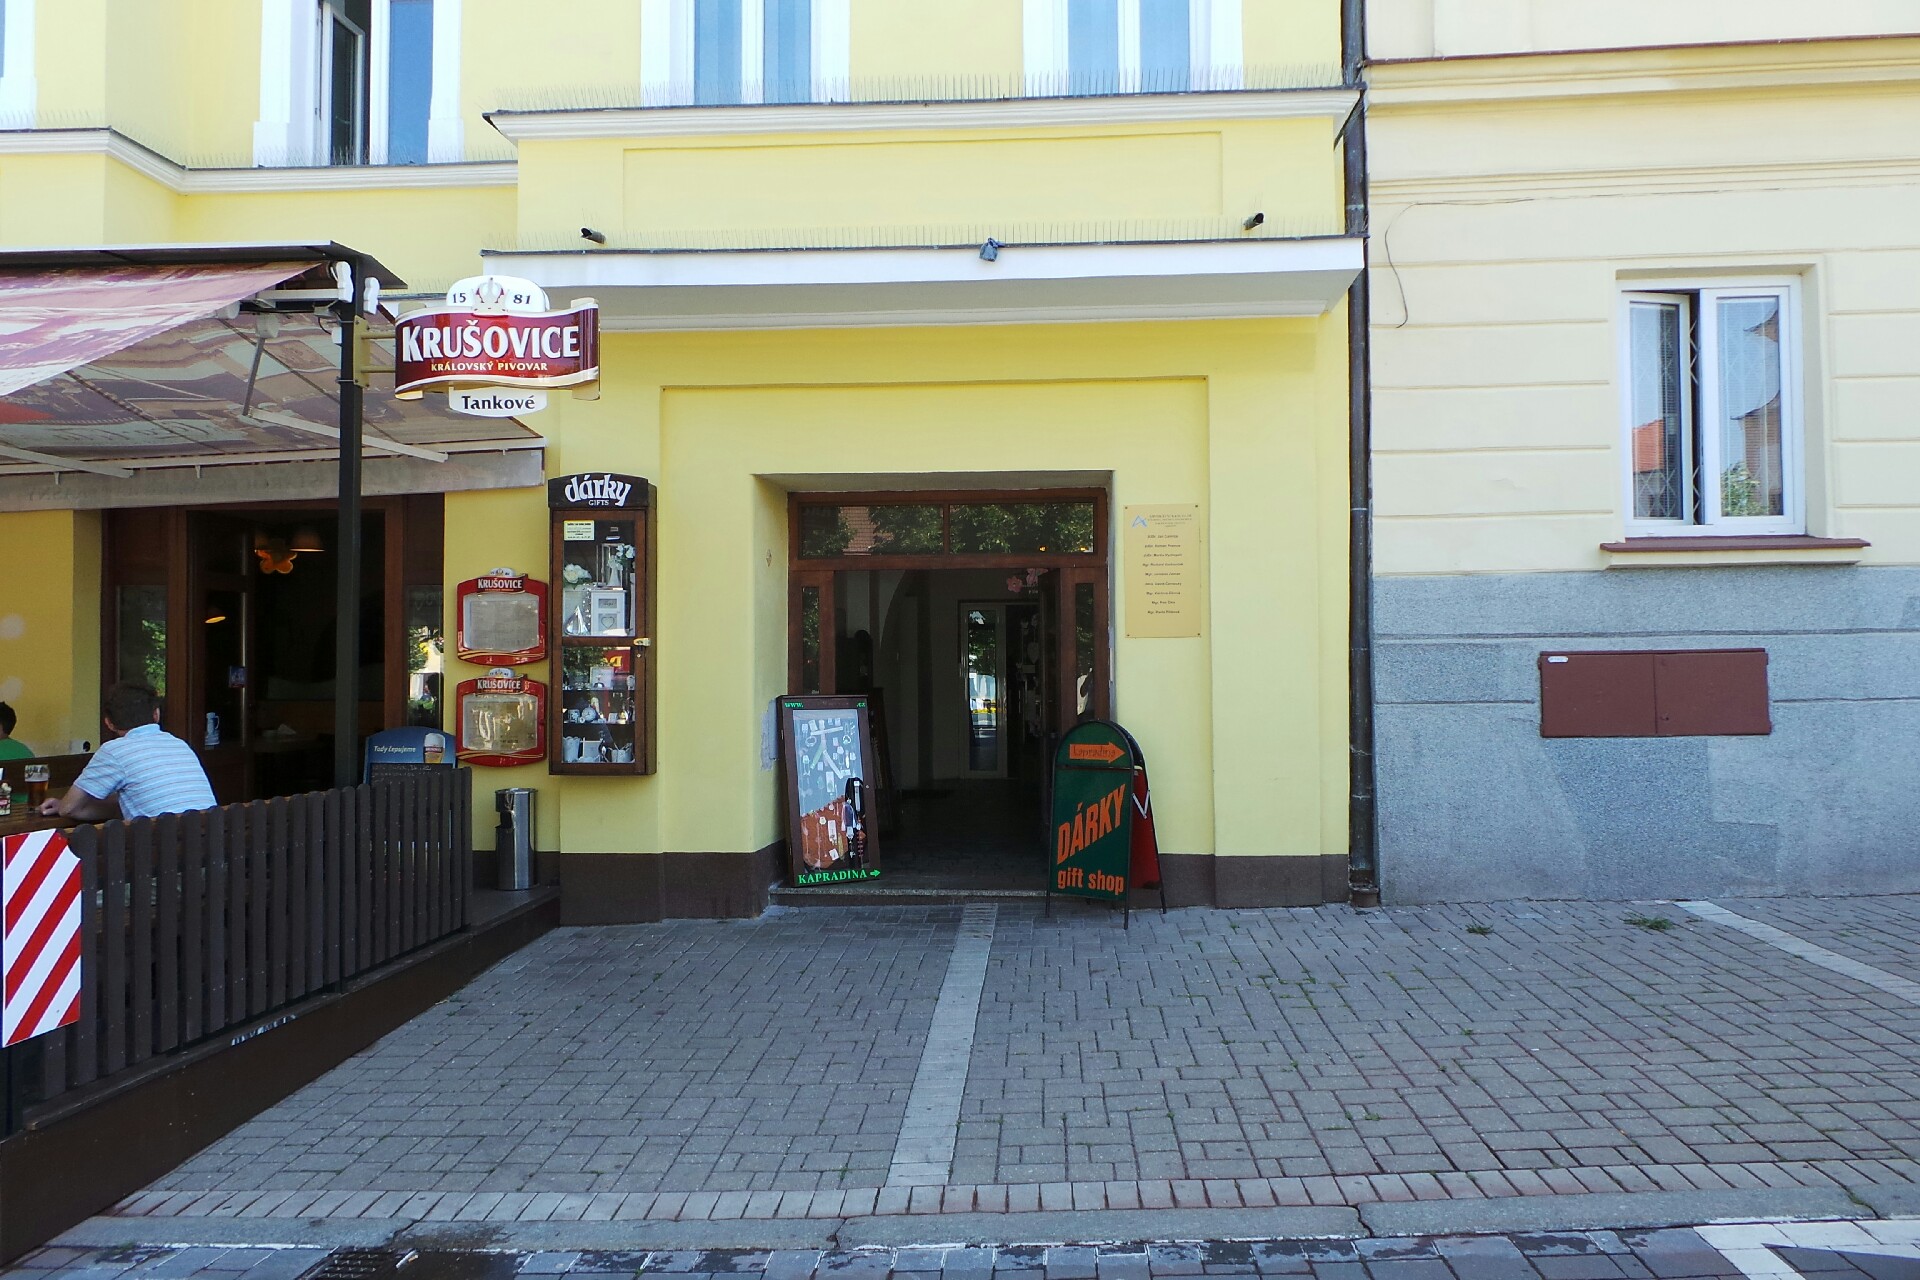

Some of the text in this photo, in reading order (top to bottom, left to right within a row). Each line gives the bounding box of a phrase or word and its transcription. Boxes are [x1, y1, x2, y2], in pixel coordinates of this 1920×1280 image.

[452, 293, 532, 305] 15 81
[402, 319, 580, 362] KRUŠOVICE
[431, 361, 548, 371] KRÁLOVSKÝ PIVOVAR
[461, 394, 536, 410] Tankové
[564, 474, 632, 507] dárky
[477, 577, 522, 589] KRUŠOVICE
[477, 678, 521, 690] KRUŠOVICE
[1056, 783, 1126, 865] DÁRKY
[798, 868, 868, 885] KAPRADINA
[1057, 867, 1125, 896] gift shop
